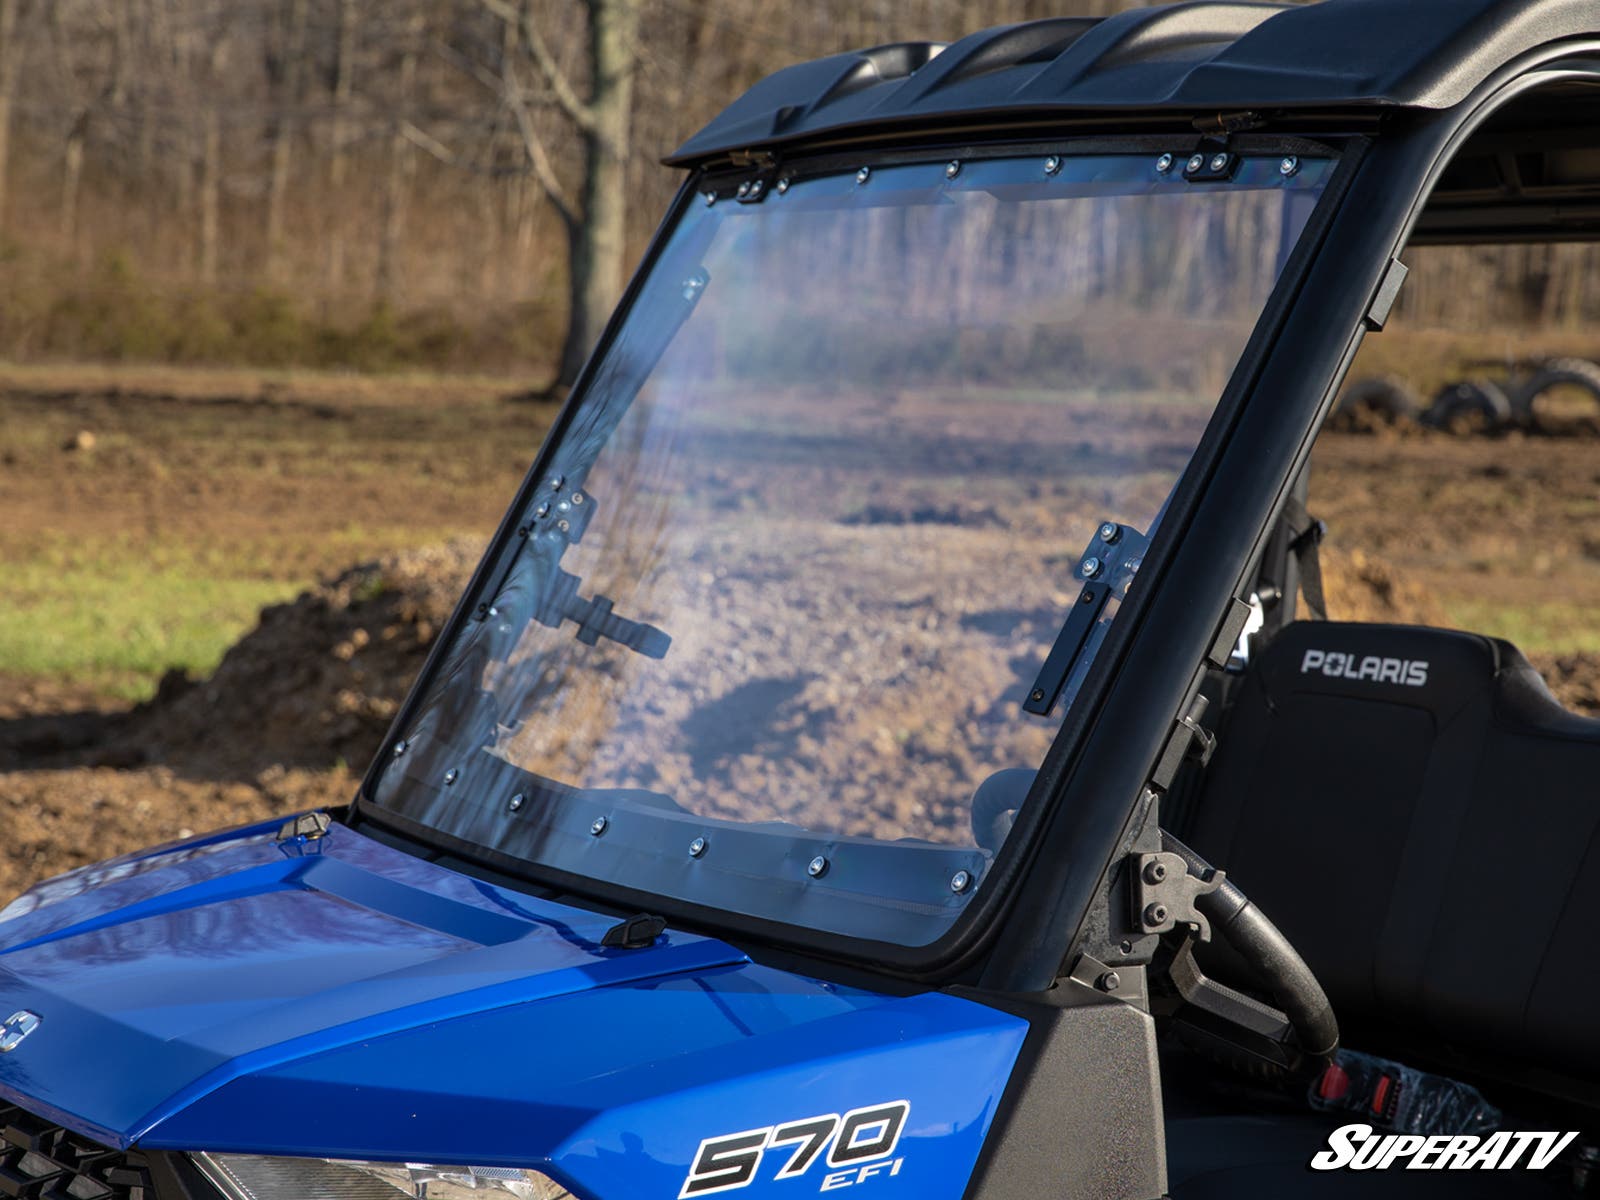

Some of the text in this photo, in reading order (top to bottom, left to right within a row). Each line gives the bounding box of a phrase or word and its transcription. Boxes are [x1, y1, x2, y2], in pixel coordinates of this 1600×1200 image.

[1302, 650, 1429, 686] POLARIS
[677, 1099, 911, 1199] 570
[820, 1158, 904, 1192] EFI
